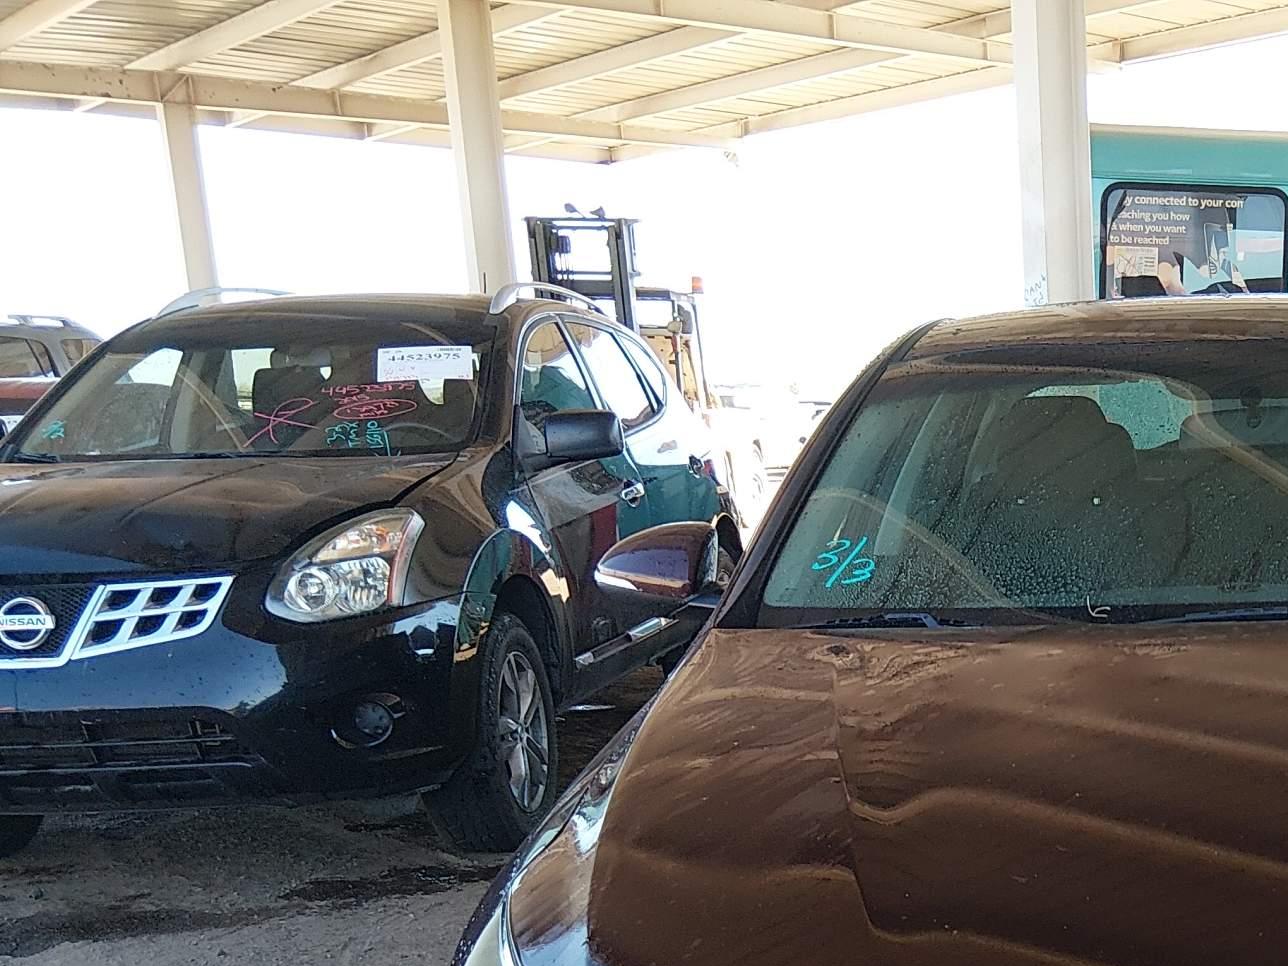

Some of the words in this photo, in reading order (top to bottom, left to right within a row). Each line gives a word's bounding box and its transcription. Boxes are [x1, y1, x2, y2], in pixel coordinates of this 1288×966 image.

[1135, 195, 1186, 206] connected
[1188, 197, 1199, 207] to
[1200, 199, 1224, 209] your
[1152, 212, 1168, 221] you
[1170, 210, 1190, 221] how
[1119, 222, 1143, 231] when
[1144, 225, 1162, 234] you
[1163, 224, 1186, 233] want
[1110, 235, 1119, 243] to
[1121, 235, 1132, 244] be
[1134, 236, 1169, 245] reached
